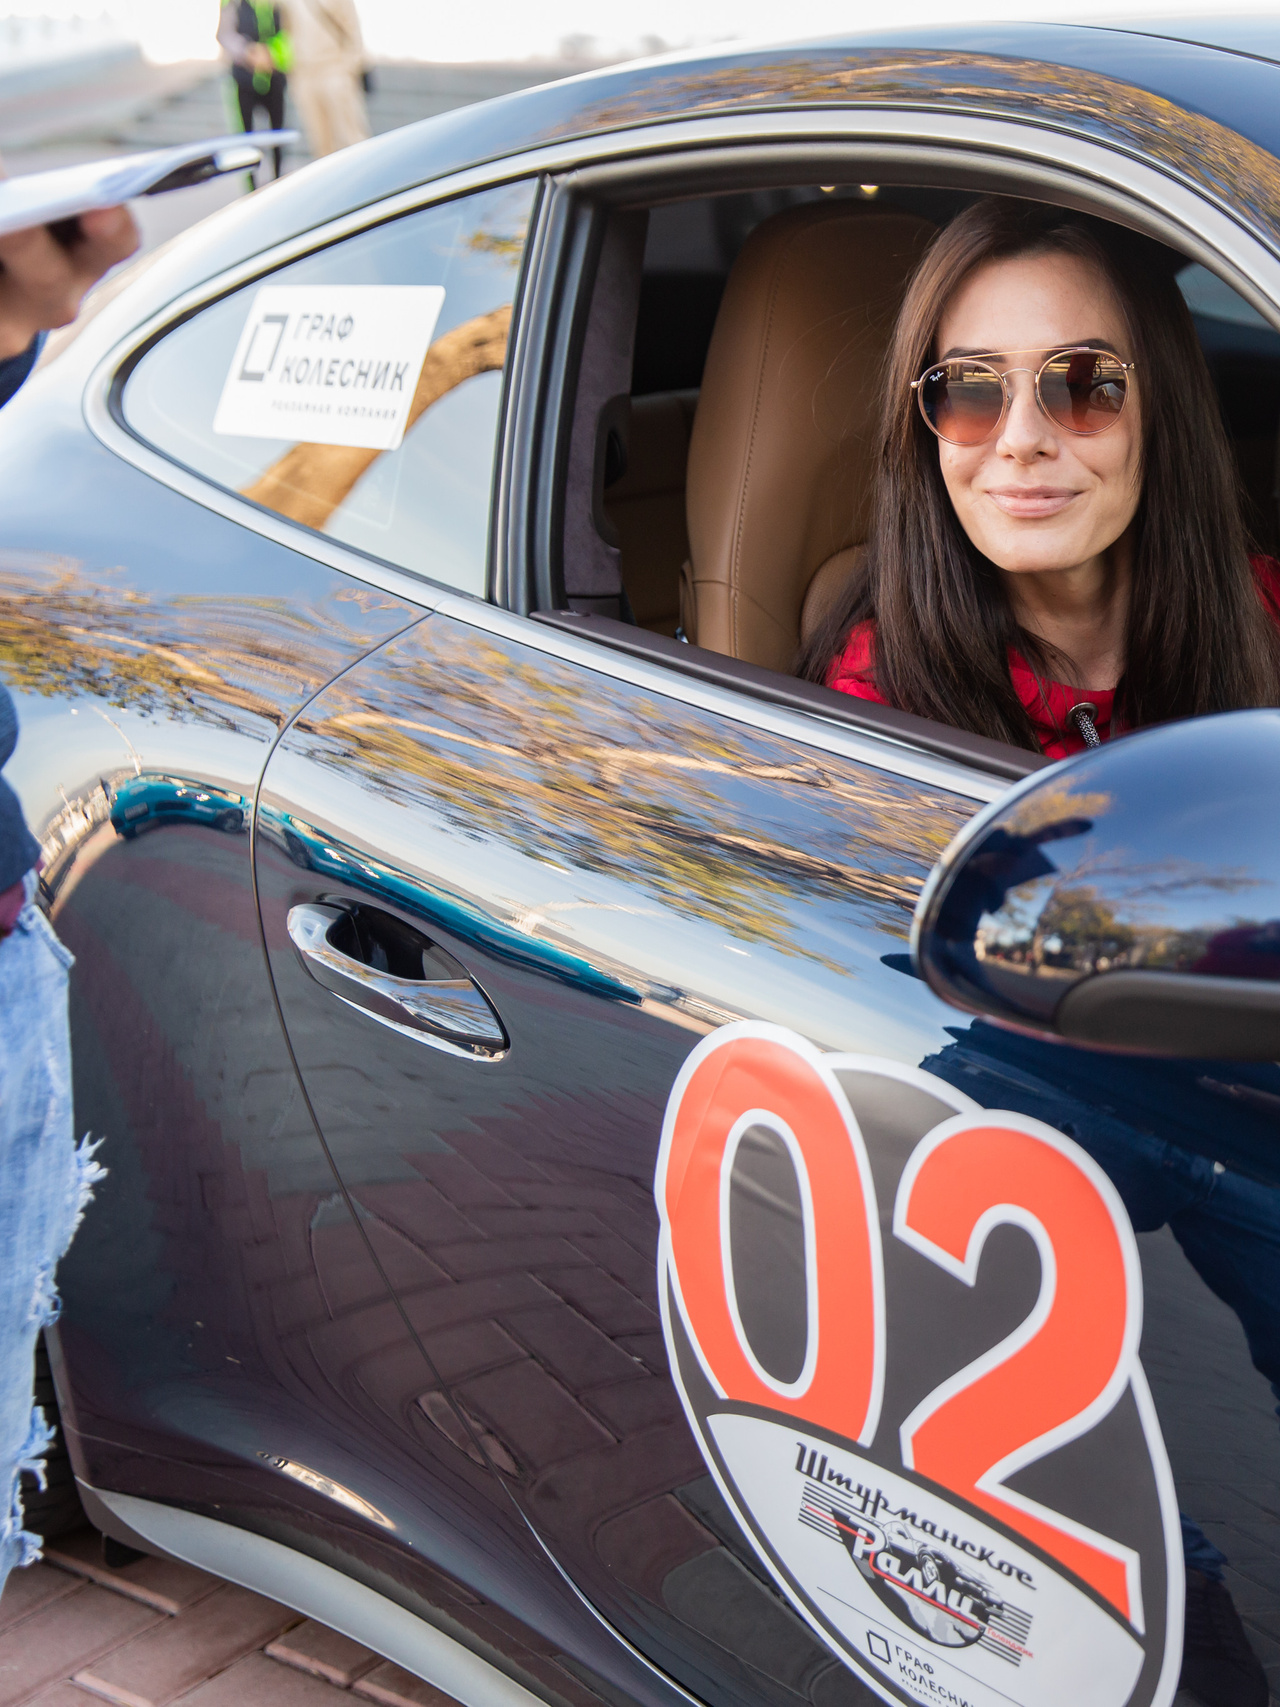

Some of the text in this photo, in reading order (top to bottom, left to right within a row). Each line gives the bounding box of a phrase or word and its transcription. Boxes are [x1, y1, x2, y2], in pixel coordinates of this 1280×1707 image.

[293, 314, 354, 341] ГРАФ
[279, 357, 409, 391] КОЛЕСНИК
[656, 1022, 1145, 1636] 02
[795, 1441, 1037, 1591] Штурманское
[848, 1516, 982, 1627] Ралли
[895, 1645, 935, 1675] ГРАФ
